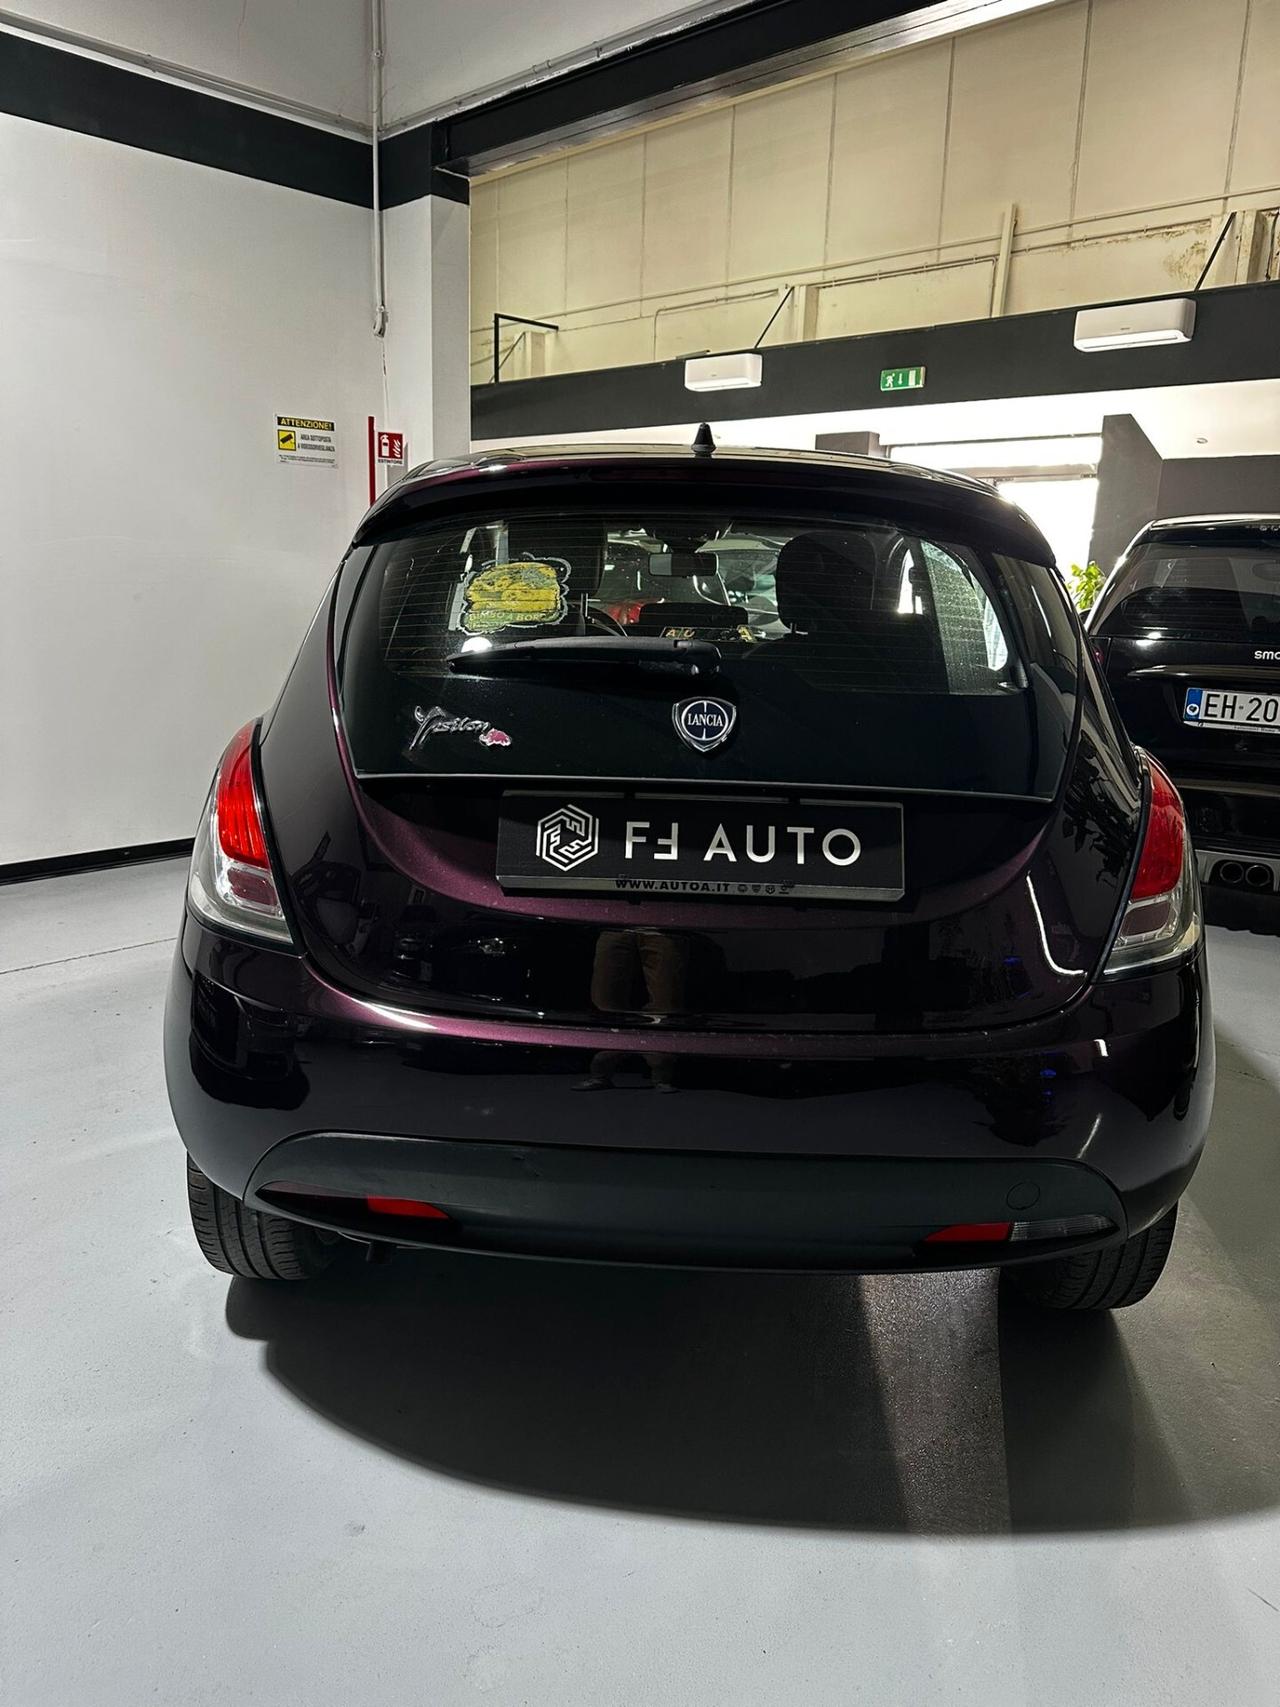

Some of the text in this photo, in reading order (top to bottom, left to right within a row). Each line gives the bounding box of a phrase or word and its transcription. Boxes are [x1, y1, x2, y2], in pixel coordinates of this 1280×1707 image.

[280, 418, 333, 430] ATTENZIONE!
[687, 713, 723, 727] LANCIA
[409, 705, 489, 751] Ypsilon
[703, 823, 861, 866] AUTO
[615, 879, 731, 893] WWW.AUTOA.IT
